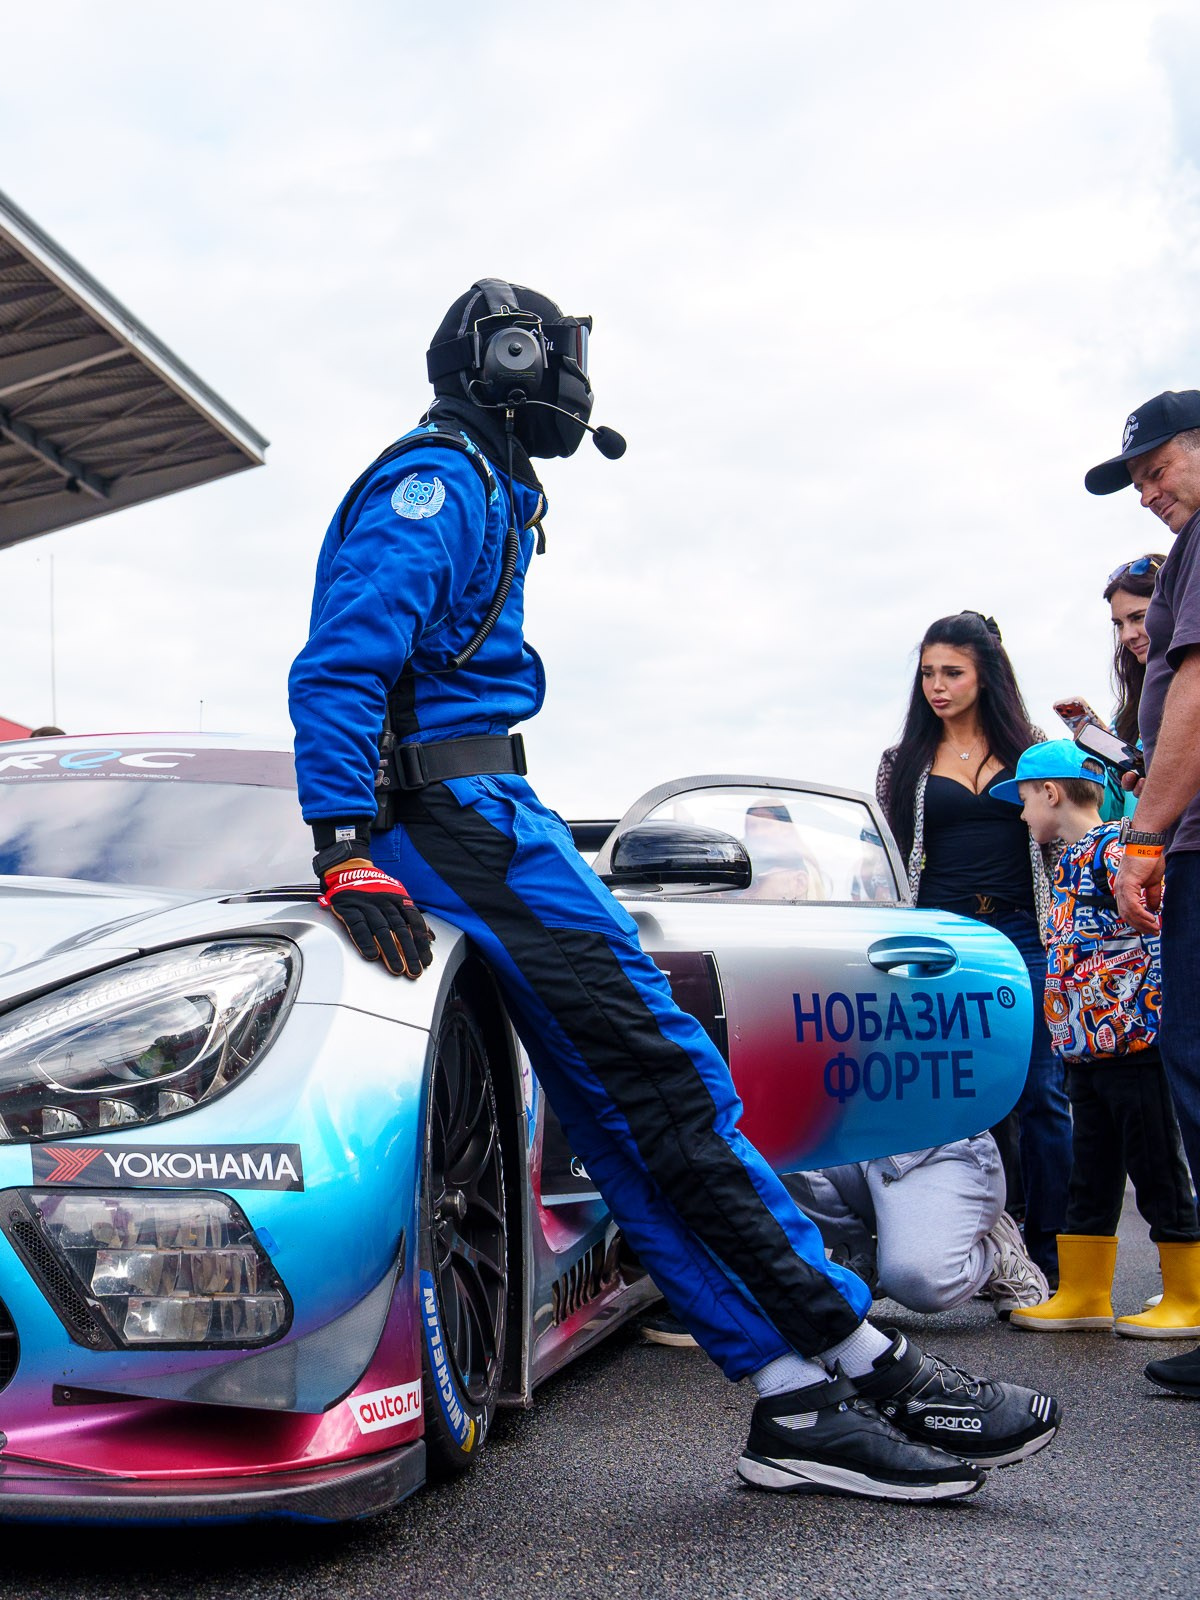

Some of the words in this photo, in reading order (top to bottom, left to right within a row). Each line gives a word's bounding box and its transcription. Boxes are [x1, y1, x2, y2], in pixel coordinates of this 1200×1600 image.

[823, 1050, 977, 1104] ФОРТЕ
[103, 1152, 300, 1182] YOKOHAMA
[423, 1287, 463, 1430] MICHELIN
[359, 1388, 420, 1424] auto.ru
[924, 1415, 982, 1430] sparco
